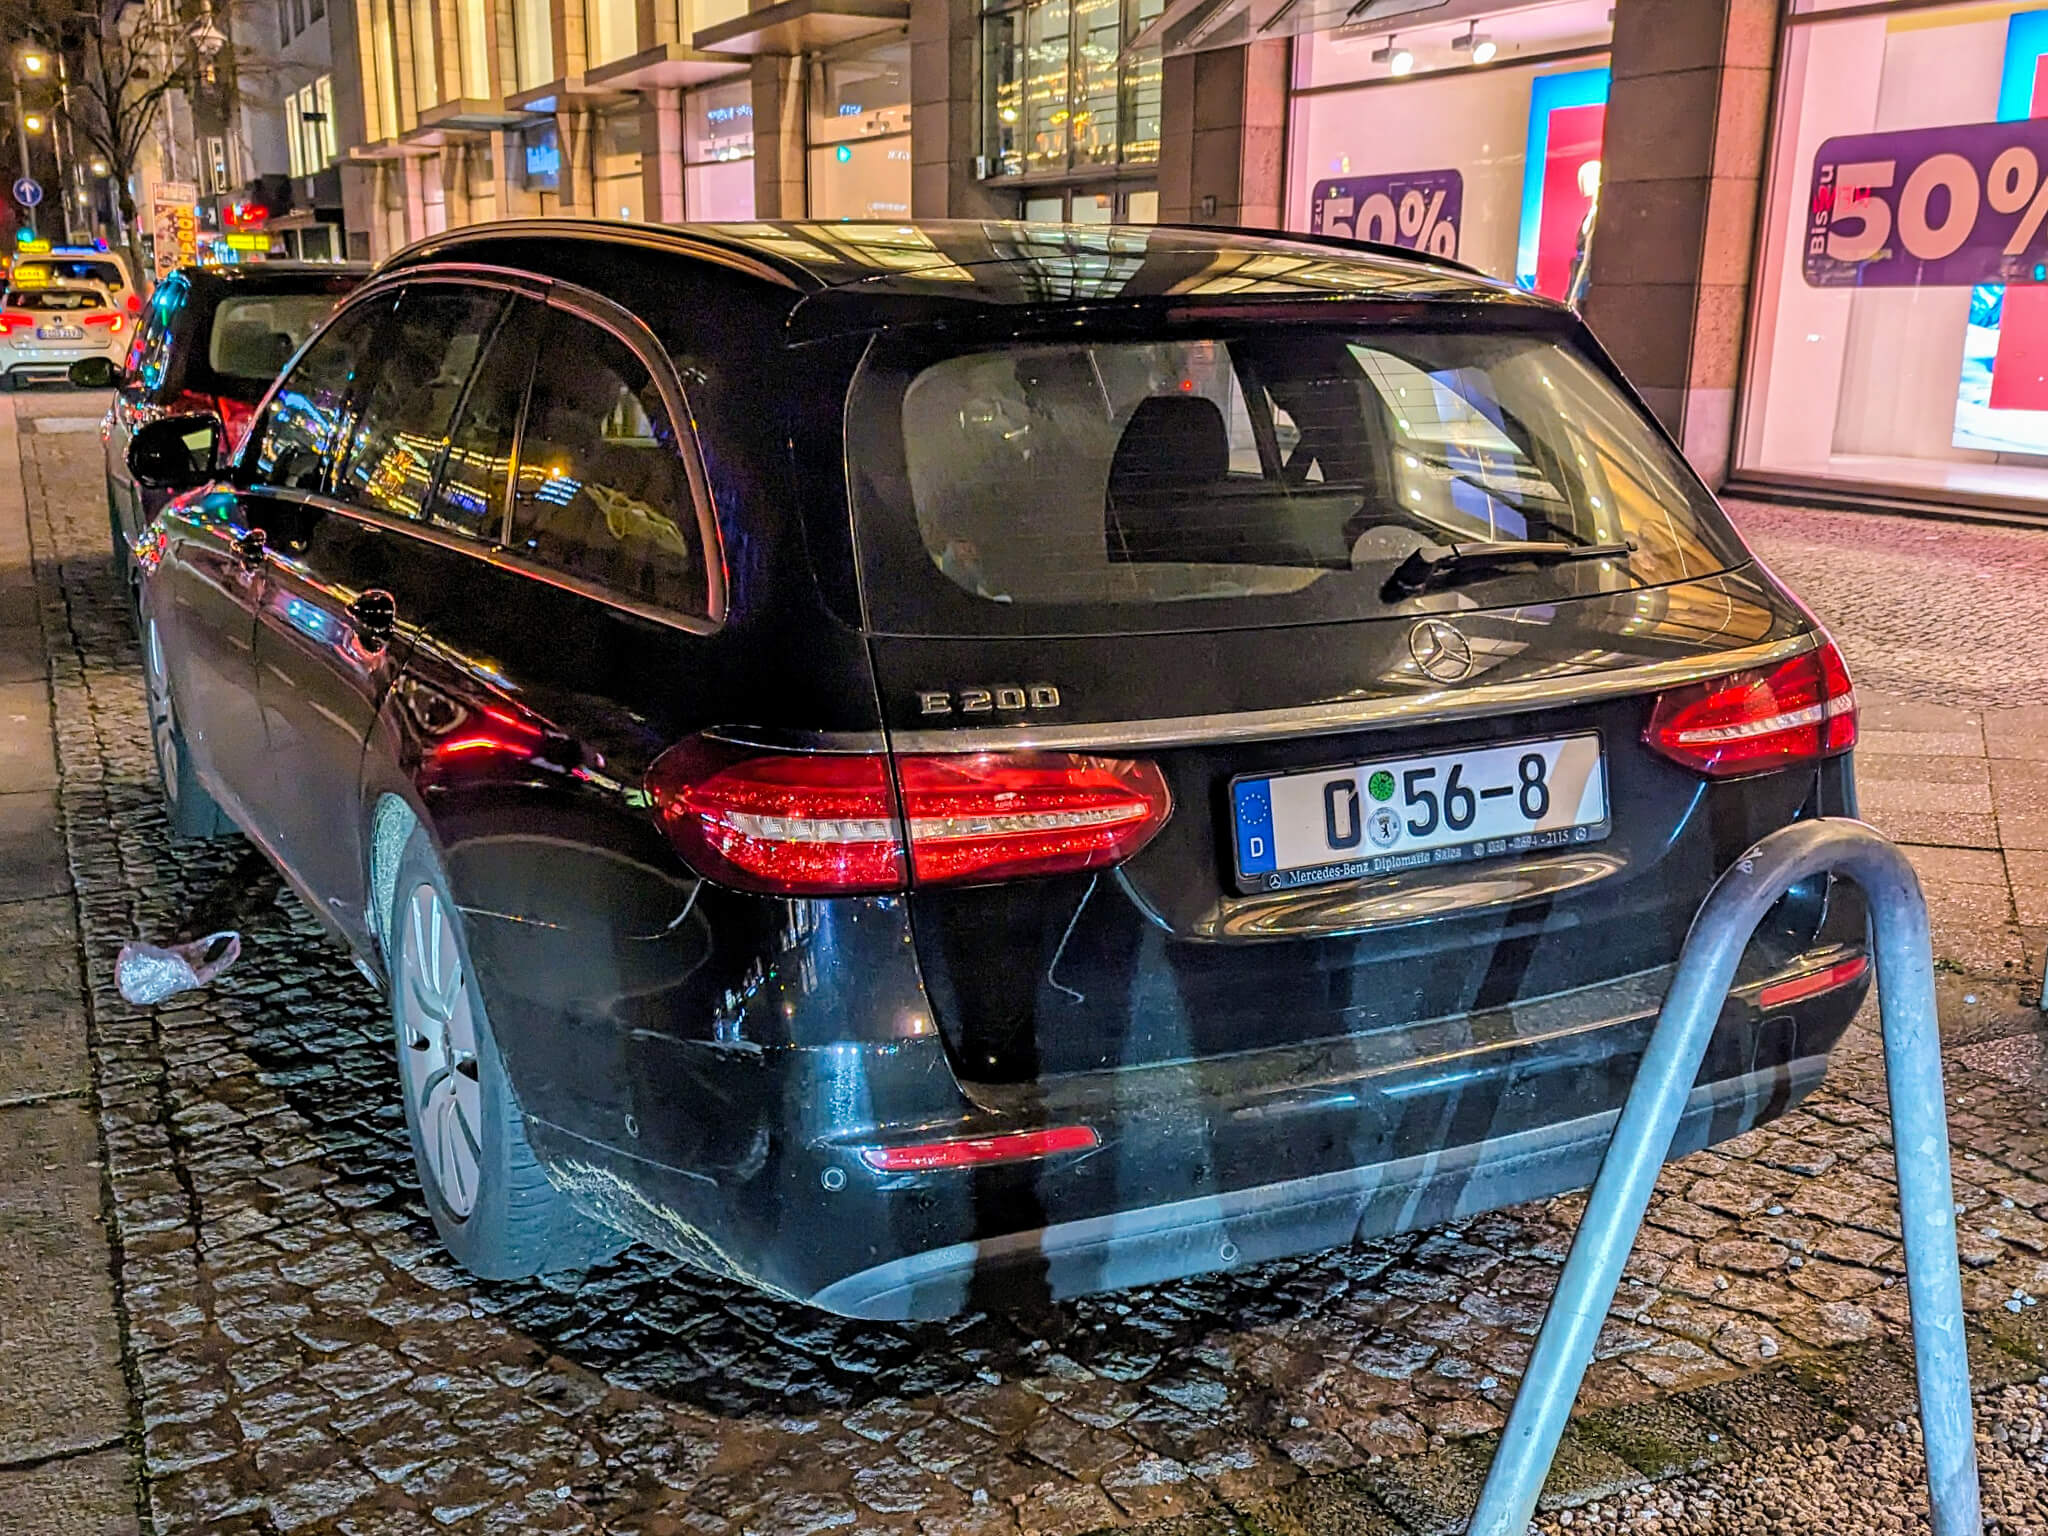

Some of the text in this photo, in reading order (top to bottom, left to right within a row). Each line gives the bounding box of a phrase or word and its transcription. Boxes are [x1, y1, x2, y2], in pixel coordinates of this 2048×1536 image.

[1322, 190, 1457, 261] 50%
[1810, 211, 1828, 255] Bis
[920, 686, 1061, 715] E 200
[1402, 753, 1551, 837] 56-8
[1250, 836, 1264, 858] D
[1289, 862, 1369, 884] Mercedes-Benz
[1374, 852, 1431, 872] Diplomatic
[1435, 847, 1462, 861] Sales
